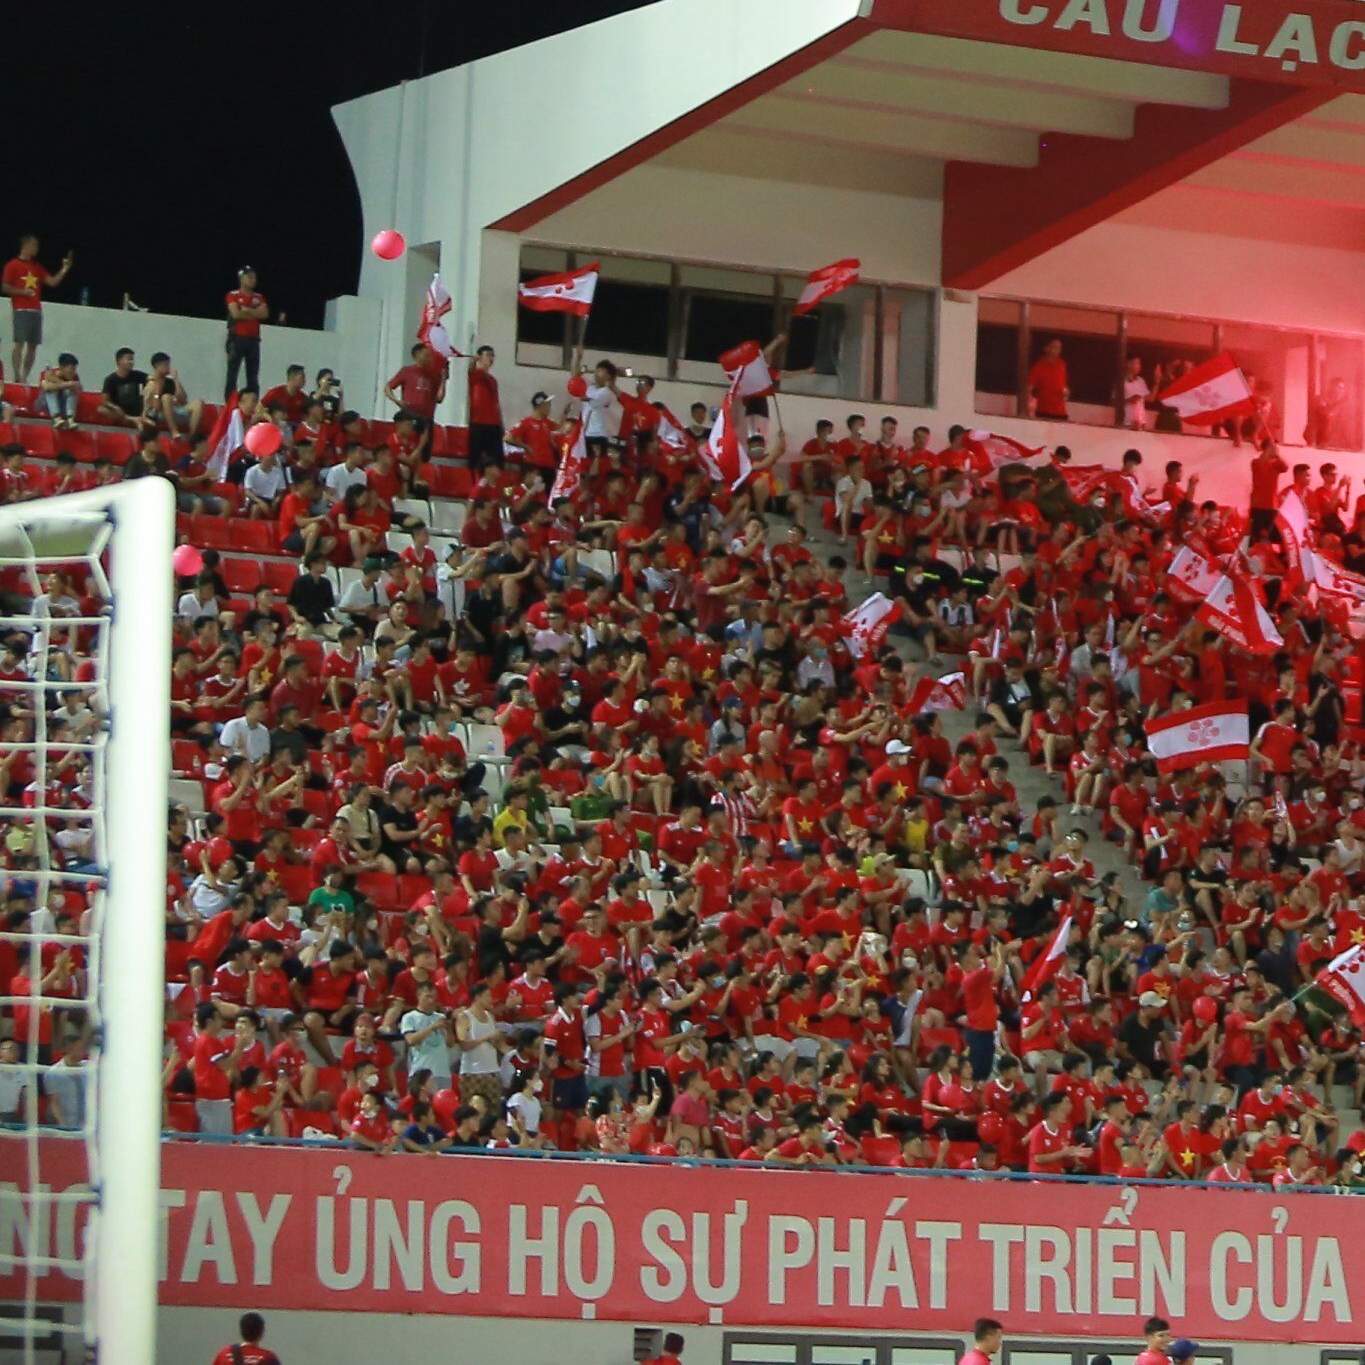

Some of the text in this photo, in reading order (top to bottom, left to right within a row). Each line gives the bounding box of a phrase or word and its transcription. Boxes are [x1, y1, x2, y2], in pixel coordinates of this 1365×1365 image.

[315, 1165, 481, 1295] ỦNG
[508, 1185, 615, 1319] HỘ
[641, 1199, 748, 1324] SỰ
[768, 1197, 962, 1310] PHÁT
[978, 1187, 1186, 1317] TRIỂN
[1209, 1206, 1352, 1324] CỦA
